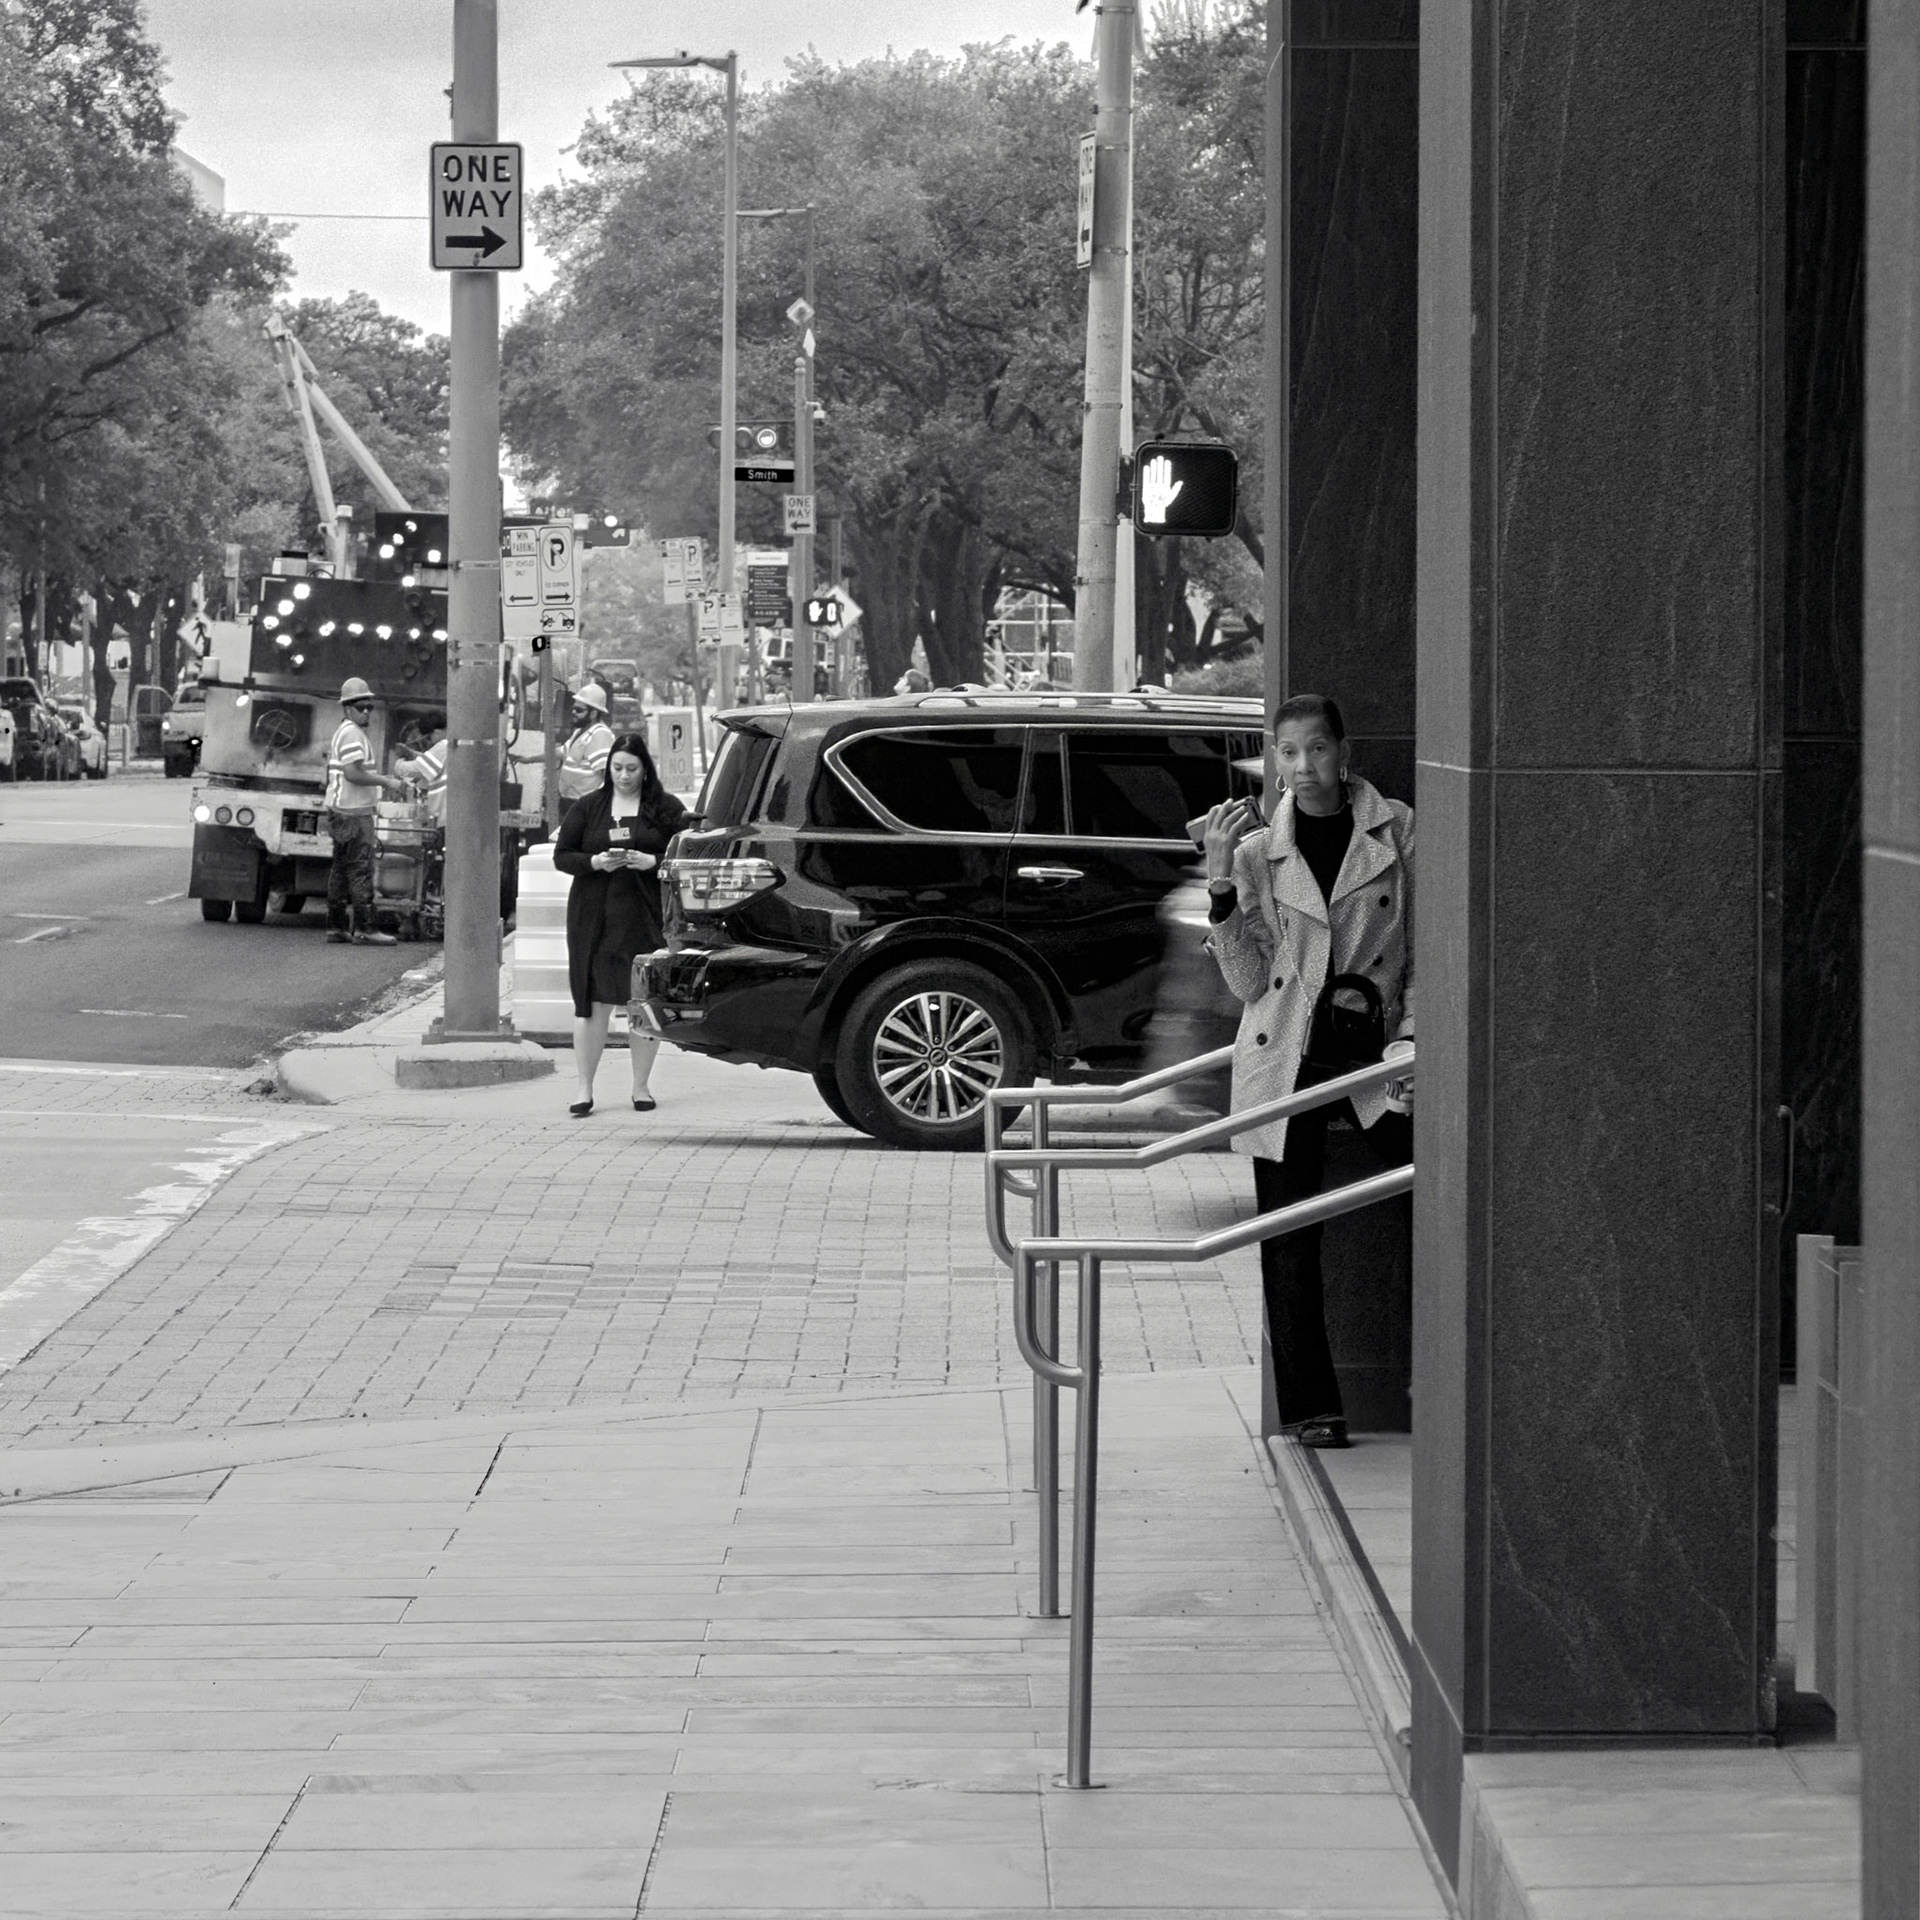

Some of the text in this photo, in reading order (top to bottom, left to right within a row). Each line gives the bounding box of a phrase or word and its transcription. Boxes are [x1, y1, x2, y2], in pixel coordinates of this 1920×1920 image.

[443, 155, 511, 182] ONE
[1081, 145, 1094, 176] ONE
[443, 190, 512, 217] WAY
[747, 469, 778, 480] Smith
[788, 497, 811, 507] ONE
[787, 508, 811, 518] WAY
